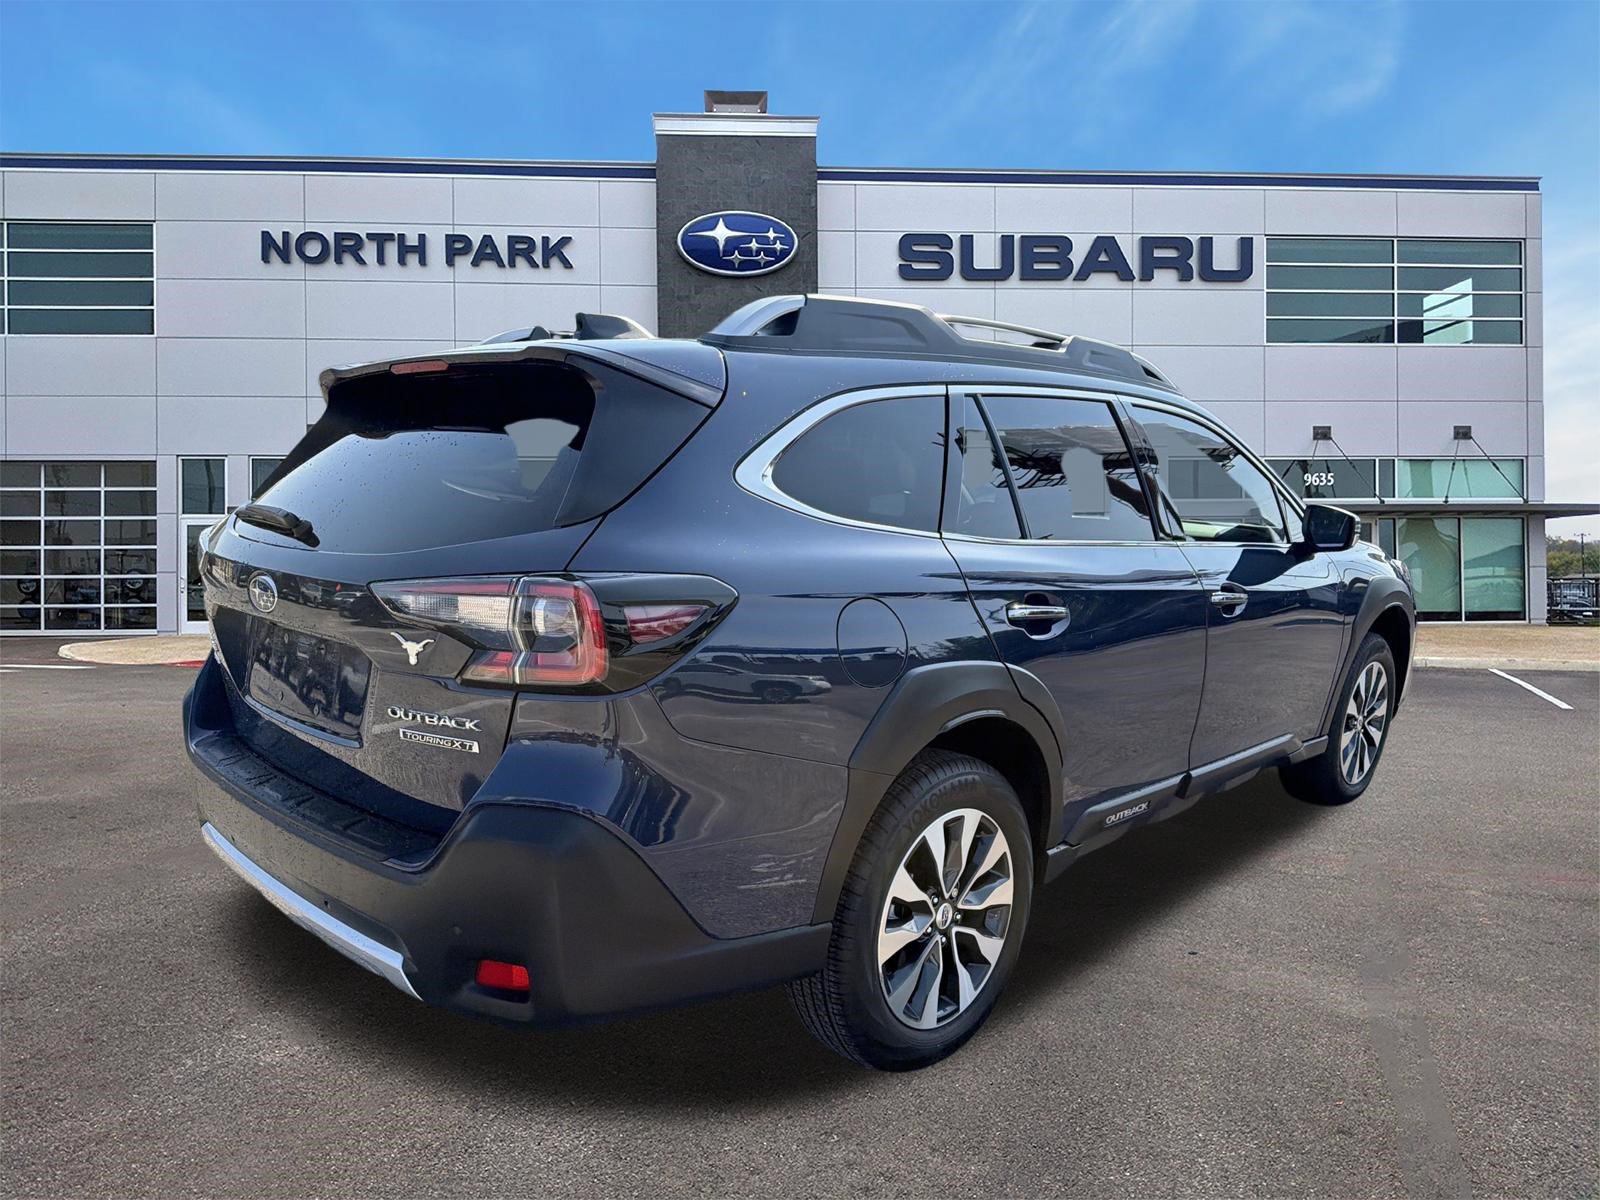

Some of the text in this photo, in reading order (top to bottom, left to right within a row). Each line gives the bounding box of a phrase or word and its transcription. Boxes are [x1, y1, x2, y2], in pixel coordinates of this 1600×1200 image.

[261, 230, 574, 269] NORTH PARK
[898, 233, 1254, 282] SUBARU
[1304, 472, 1335, 486] 9635
[387, 704, 481, 731] OUTBACK
[1105, 801, 1150, 825] OUTBACK
